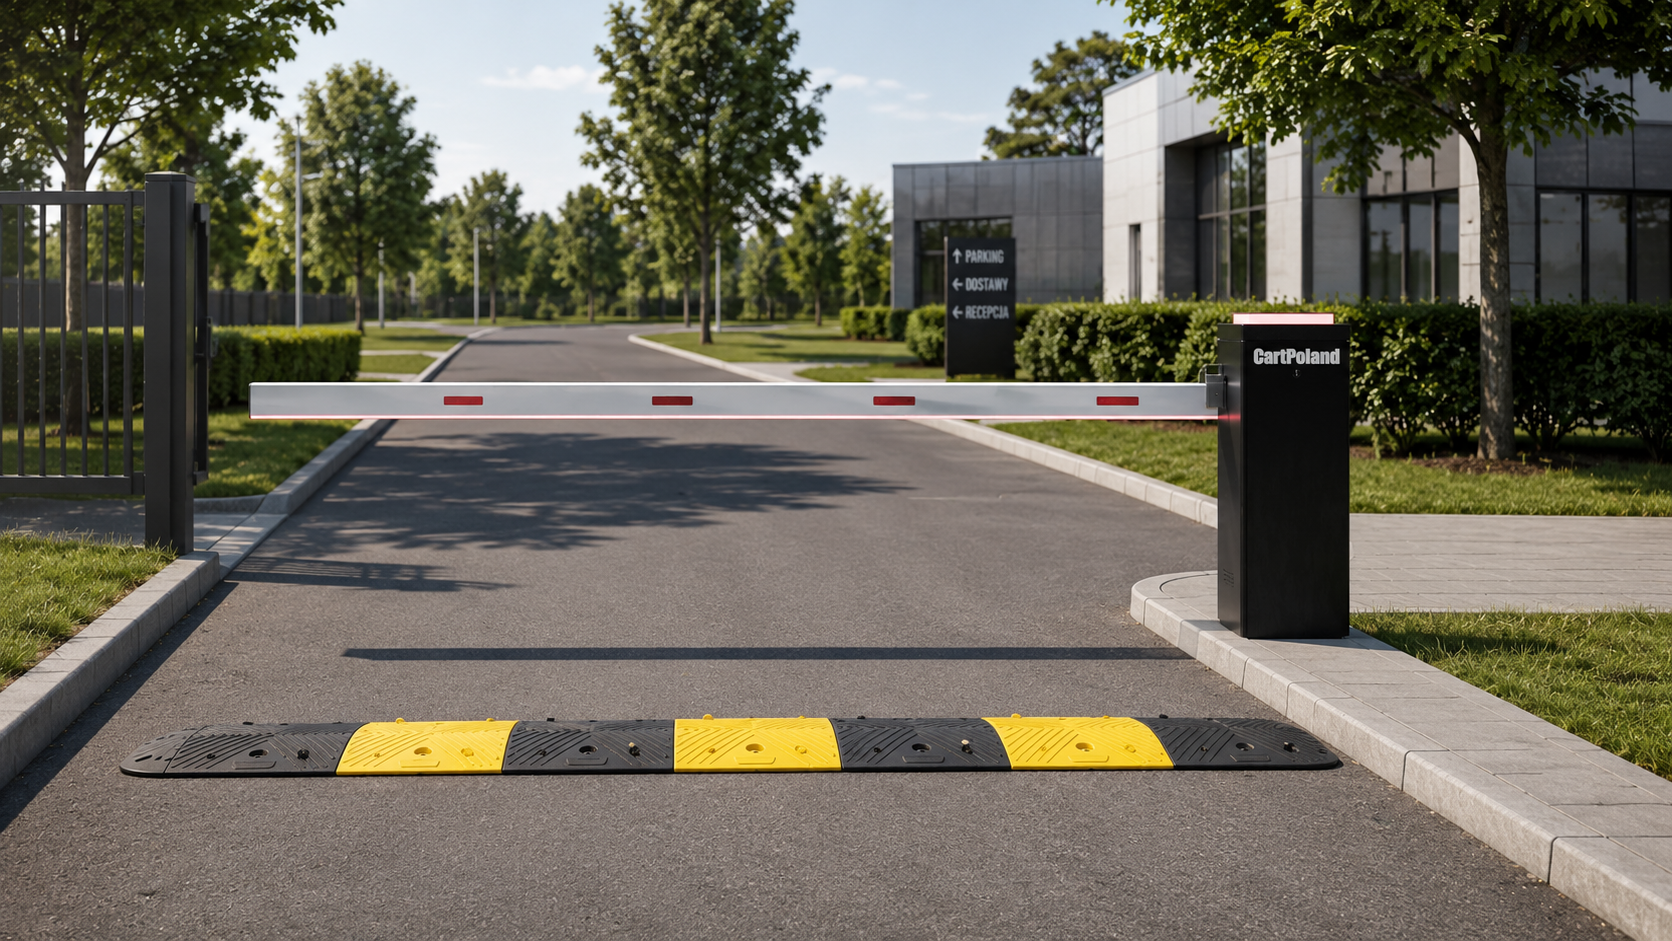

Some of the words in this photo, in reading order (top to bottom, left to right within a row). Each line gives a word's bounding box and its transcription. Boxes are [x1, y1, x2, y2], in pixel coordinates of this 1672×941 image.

[965, 249, 1004, 264] PARKING
[965, 277, 1009, 291] DOSTAWY
[965, 305, 1010, 319] RECEPCJA
[1253, 348, 1341, 365] CartPoland
